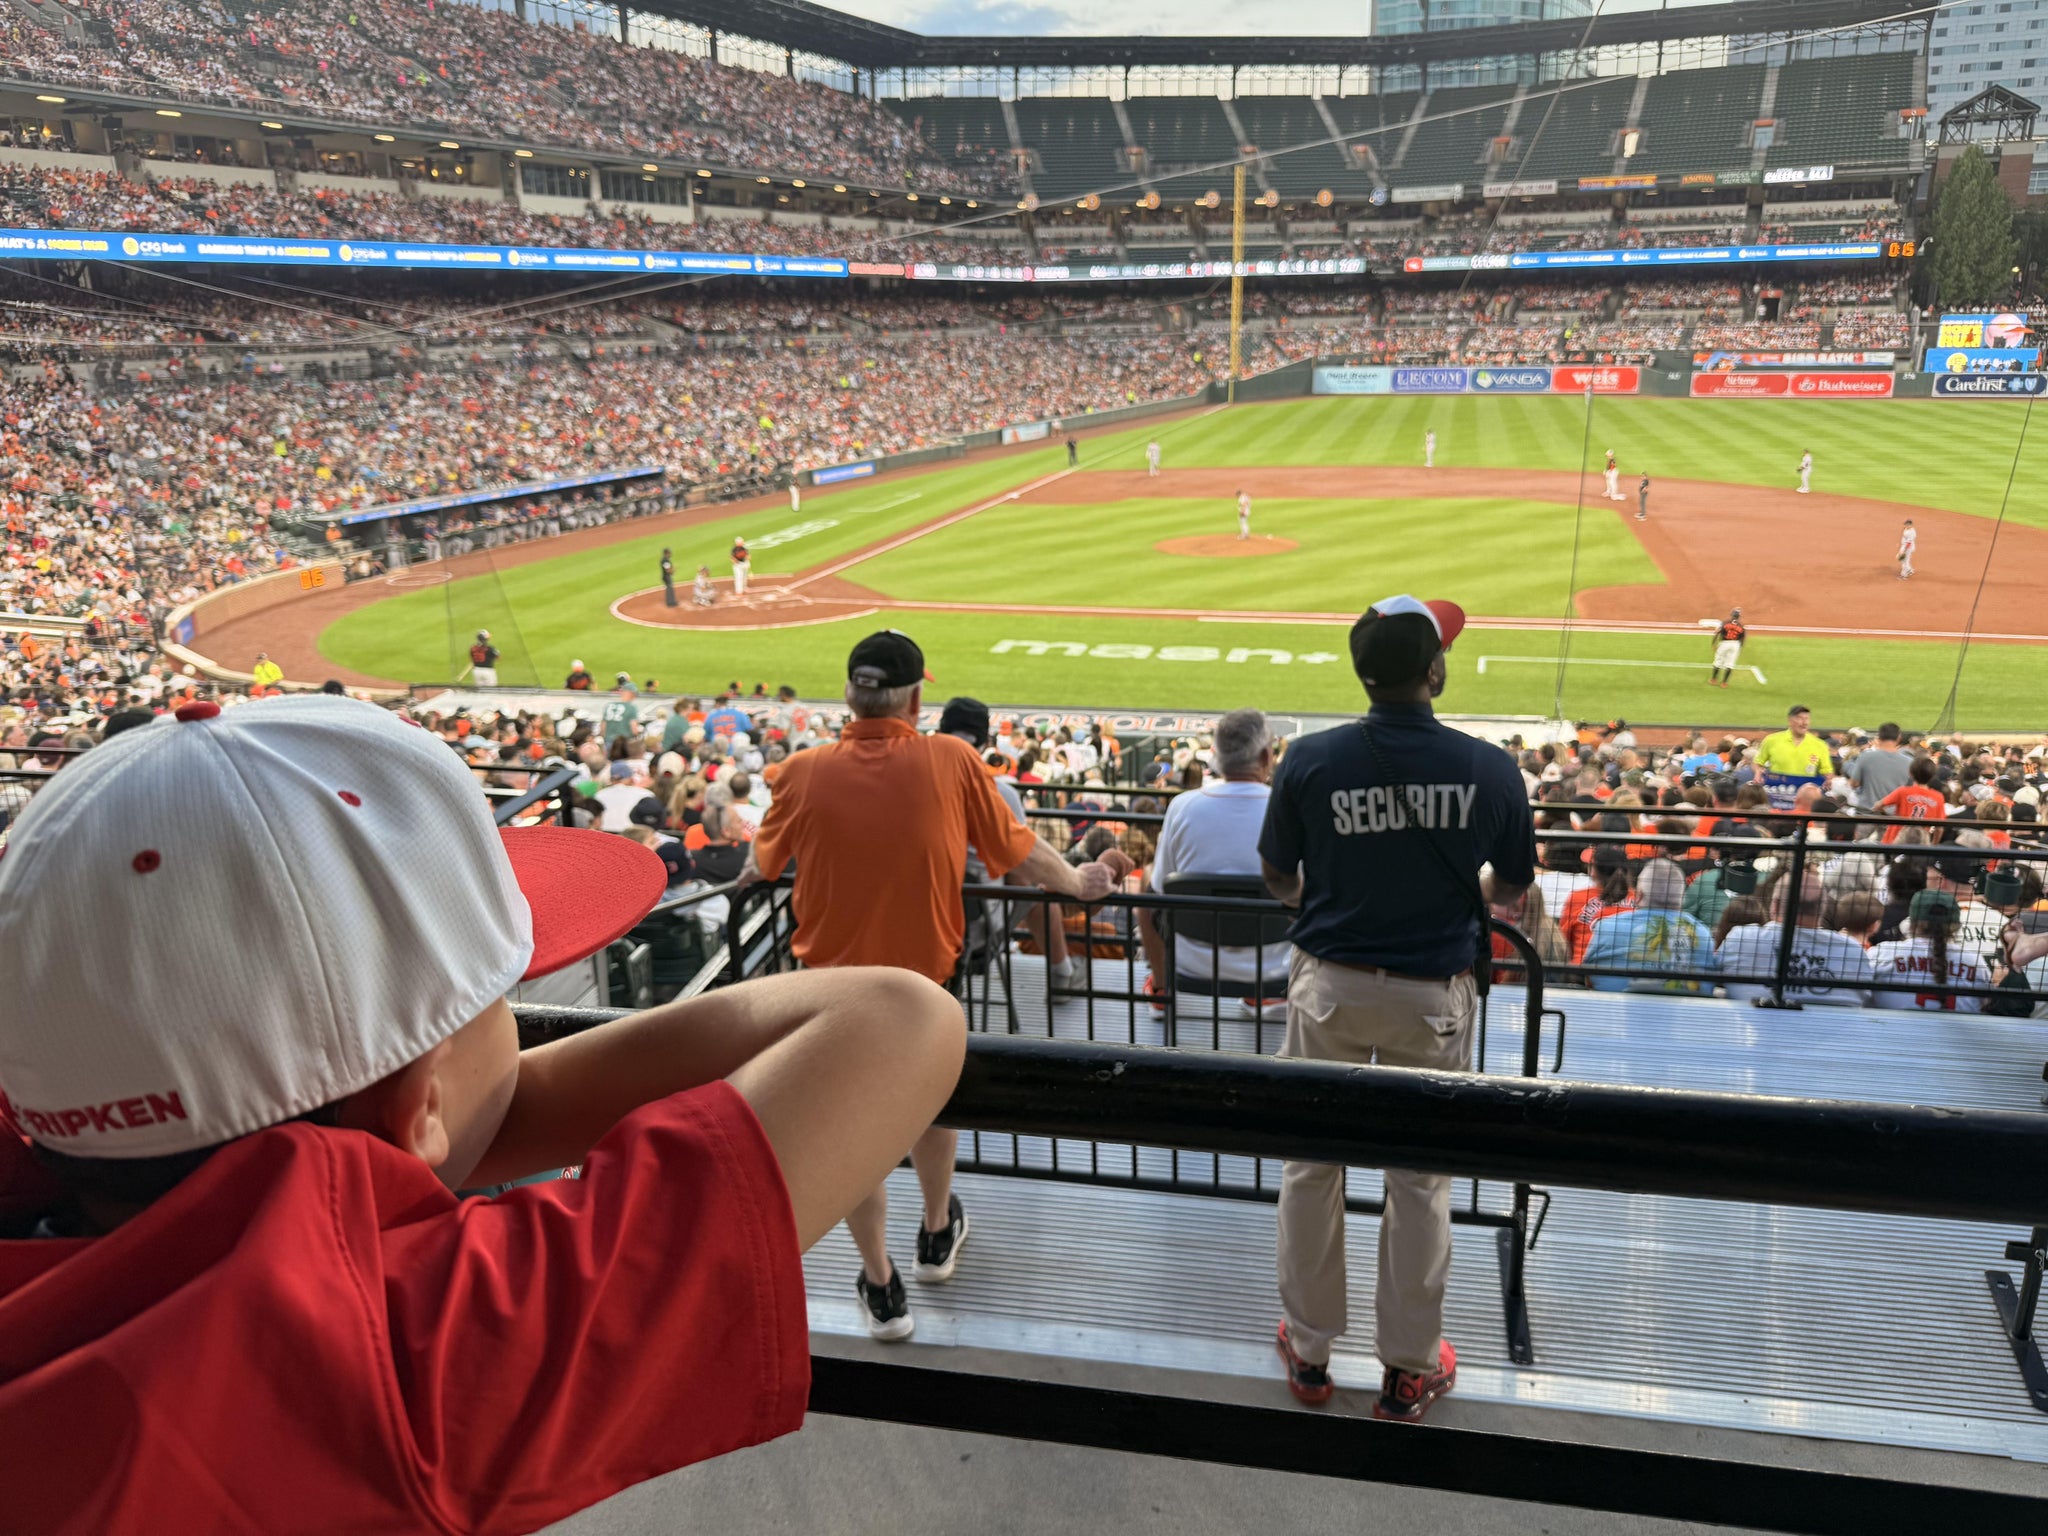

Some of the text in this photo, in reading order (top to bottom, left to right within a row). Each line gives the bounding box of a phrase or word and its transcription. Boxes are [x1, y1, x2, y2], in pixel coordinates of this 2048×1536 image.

[140, 241, 186, 254] CFG Bank
[1397, 371, 1462, 385] LECOM
[1492, 374, 1544, 385] VANDA
[1572, 370, 1620, 386] weis
[1945, 377, 2007, 392] CareFirst
[1818, 380, 1884, 392] Budweiser
[1330, 783, 1478, 836] SECURITY
[22, 1090, 188, 1138] RIPKEN
